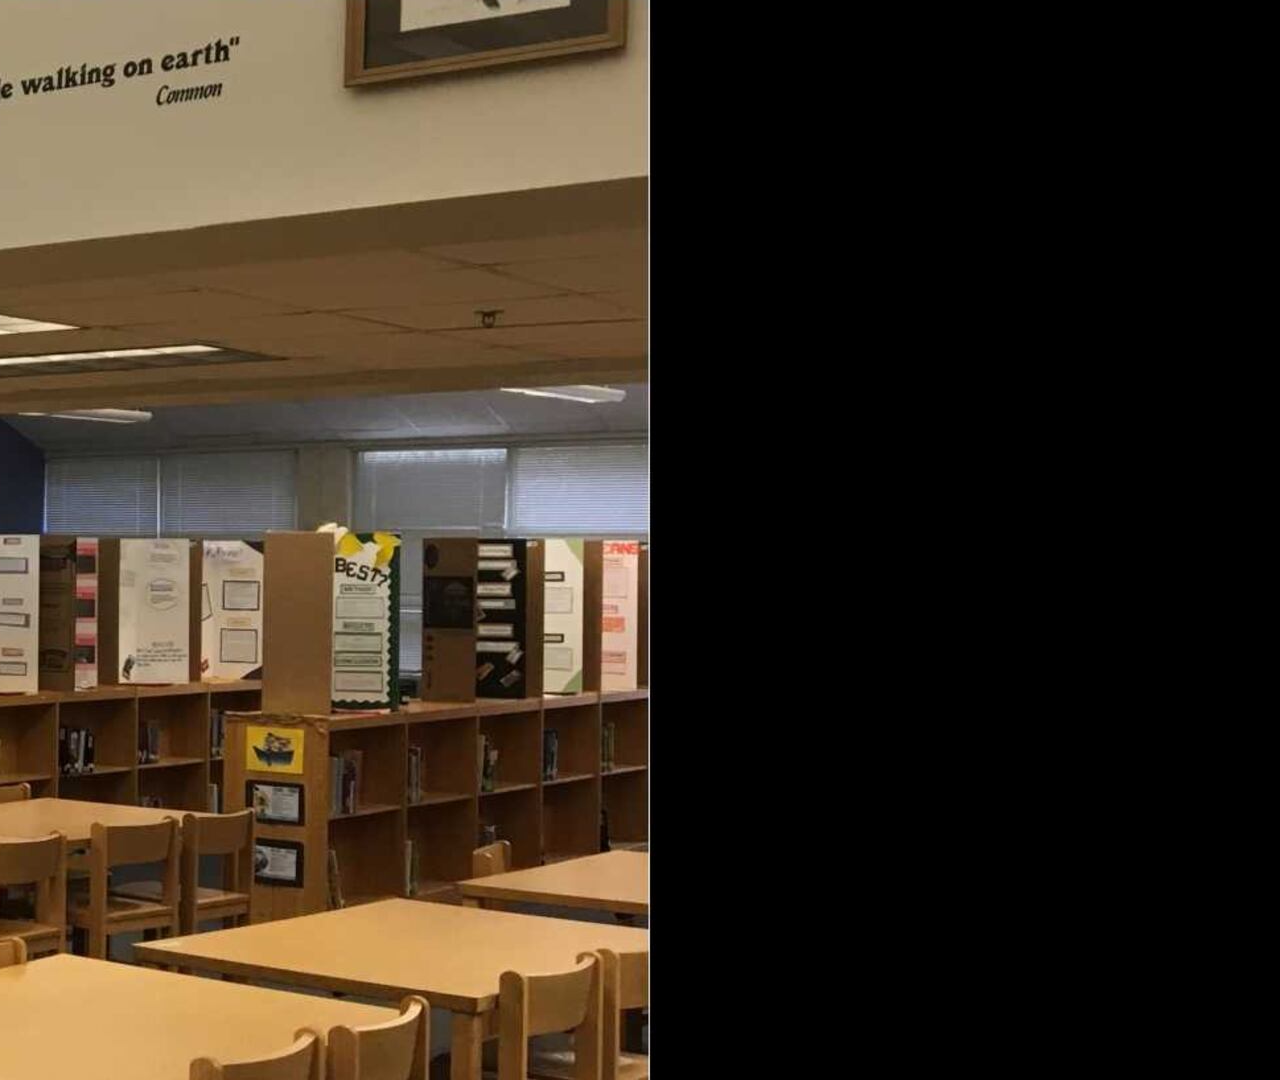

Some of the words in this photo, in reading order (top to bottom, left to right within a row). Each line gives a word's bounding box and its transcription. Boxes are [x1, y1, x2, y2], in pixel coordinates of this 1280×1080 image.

[21, 63, 117, 96] walking
[123, 57, 153, 78] on
[160, 36, 240, 72] earth"
[156, 82, 223, 107] Common
[335, 557, 388, 587] BEST?
